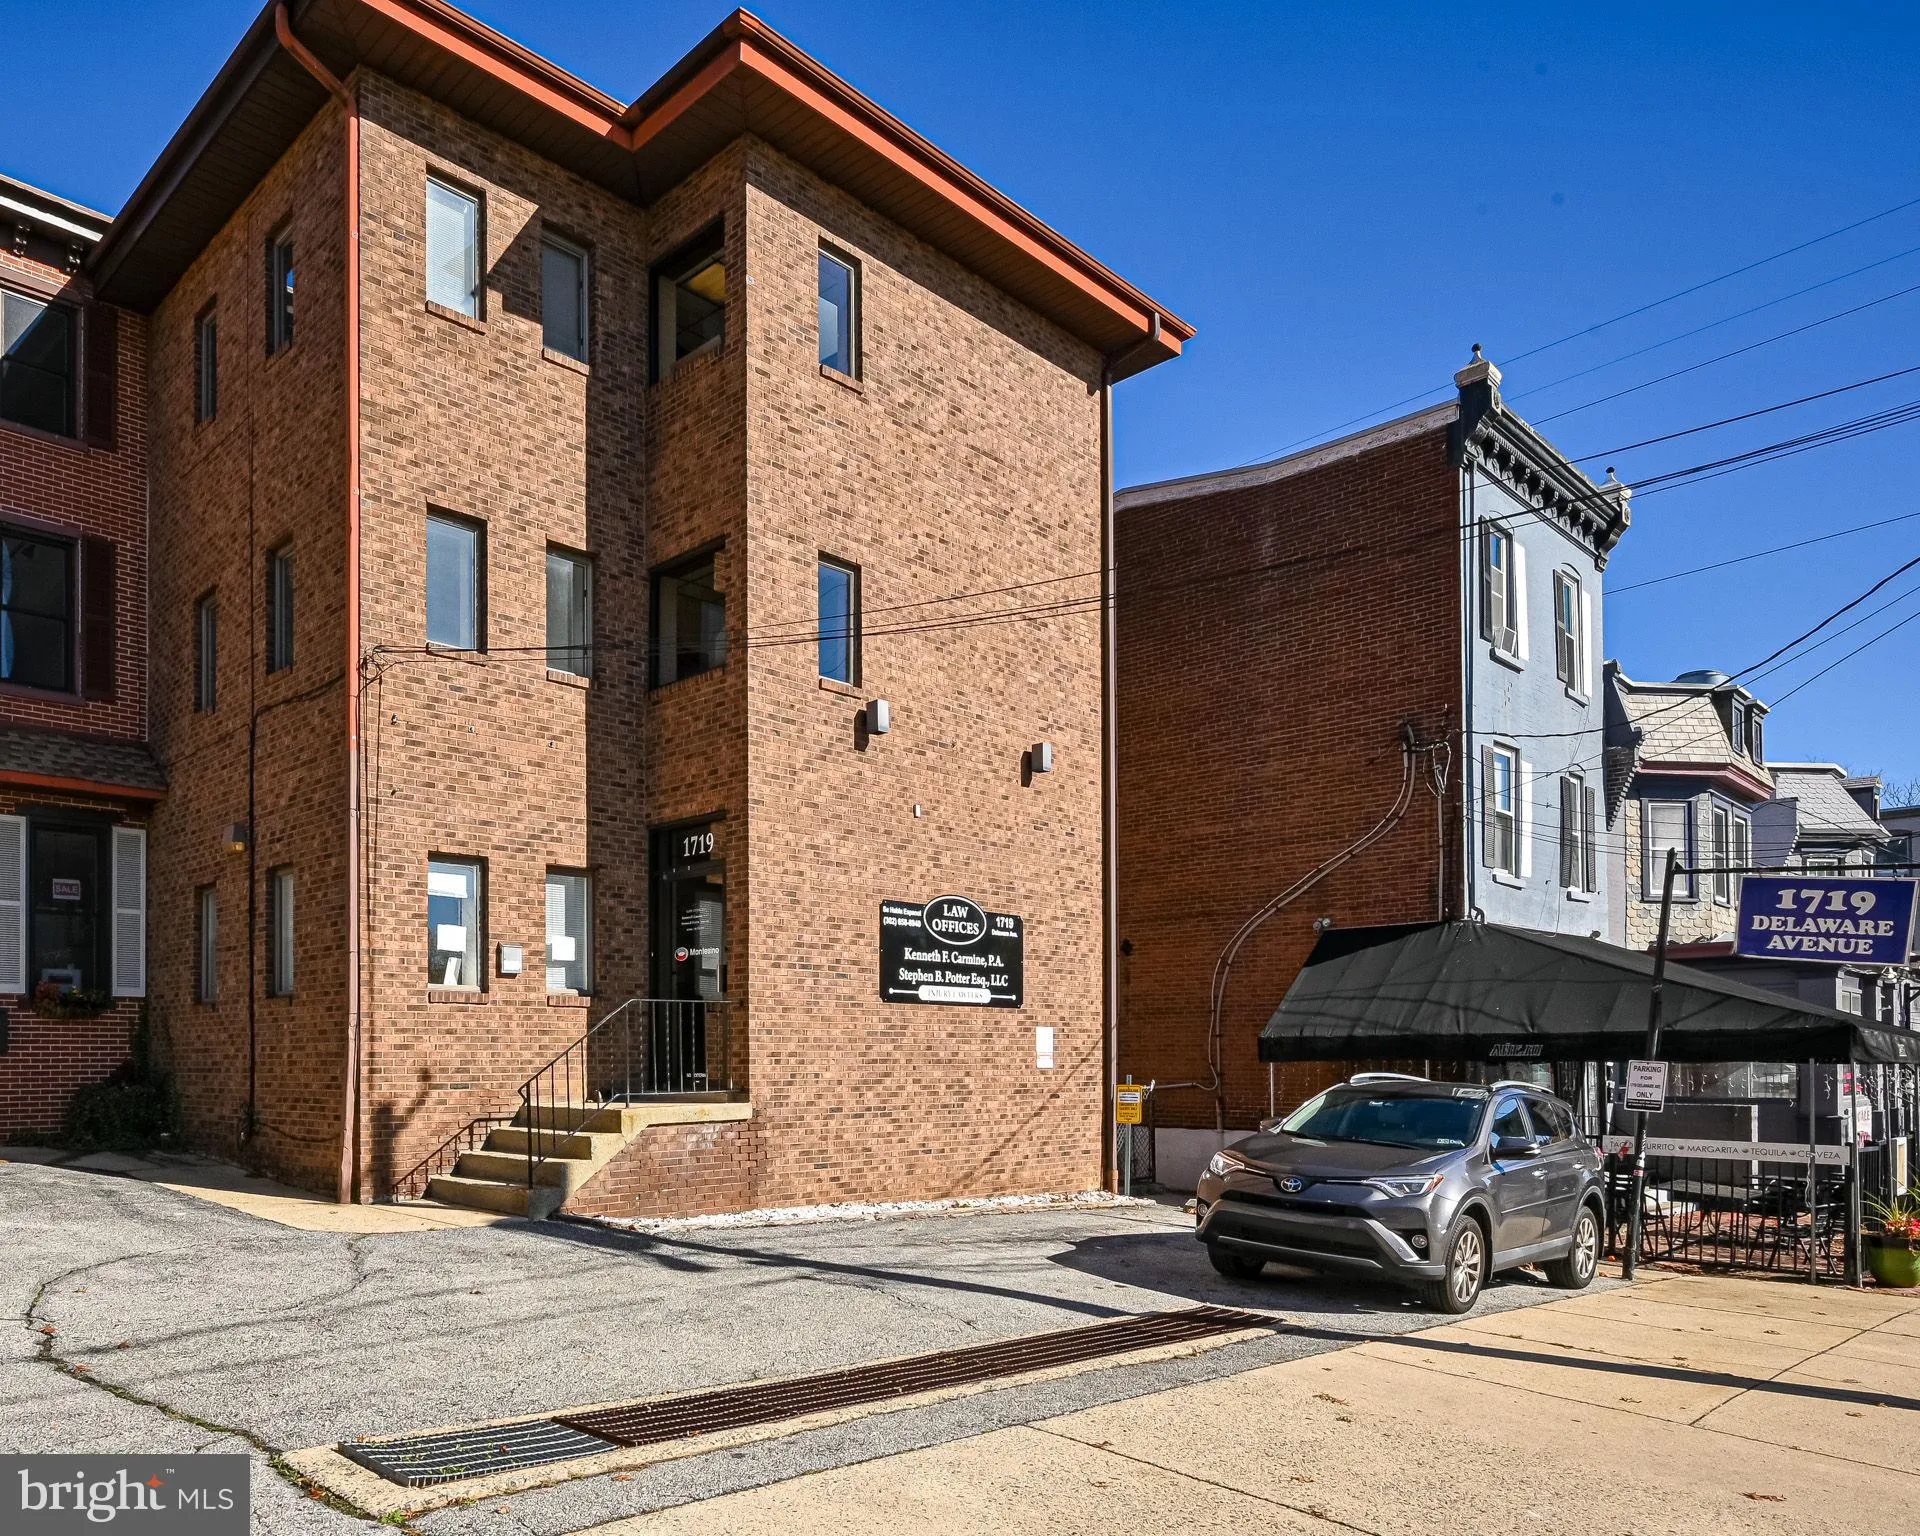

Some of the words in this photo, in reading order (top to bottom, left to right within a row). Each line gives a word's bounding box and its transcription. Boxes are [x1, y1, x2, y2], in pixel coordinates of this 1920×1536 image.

[683, 832, 714, 856] 1719
[943, 904, 969, 918] LAW
[1775, 888, 1877, 916] 1719
[932, 918, 980, 935] OFFICES
[996, 916, 1014, 929] 1719
[1751, 915, 1894, 937] DELAWARE
[690, 946, 719, 957] Montesino
[1766, 934, 1874, 955] AVENUE
[904, 947, 941, 963] Kenneth
[942, 950, 950, 963] F.
[951, 951, 988, 968] Carmine,
[988, 954, 1004, 967] P.A.
[899, 967, 934, 985] Stephen
[935, 970, 944, 983] B.
[945, 971, 970, 984] Potter
[990, 974, 1009, 987] LLC
[1633, 1065, 1662, 1073] PARKING
[1645, 1143, 1675, 1151] URRITO
[1687, 1145, 1739, 1154] MARGARITA
[1750, 1148, 1788, 1156] TEQUILA
[1797, 1149, 1841, 1159] CEVEZA
